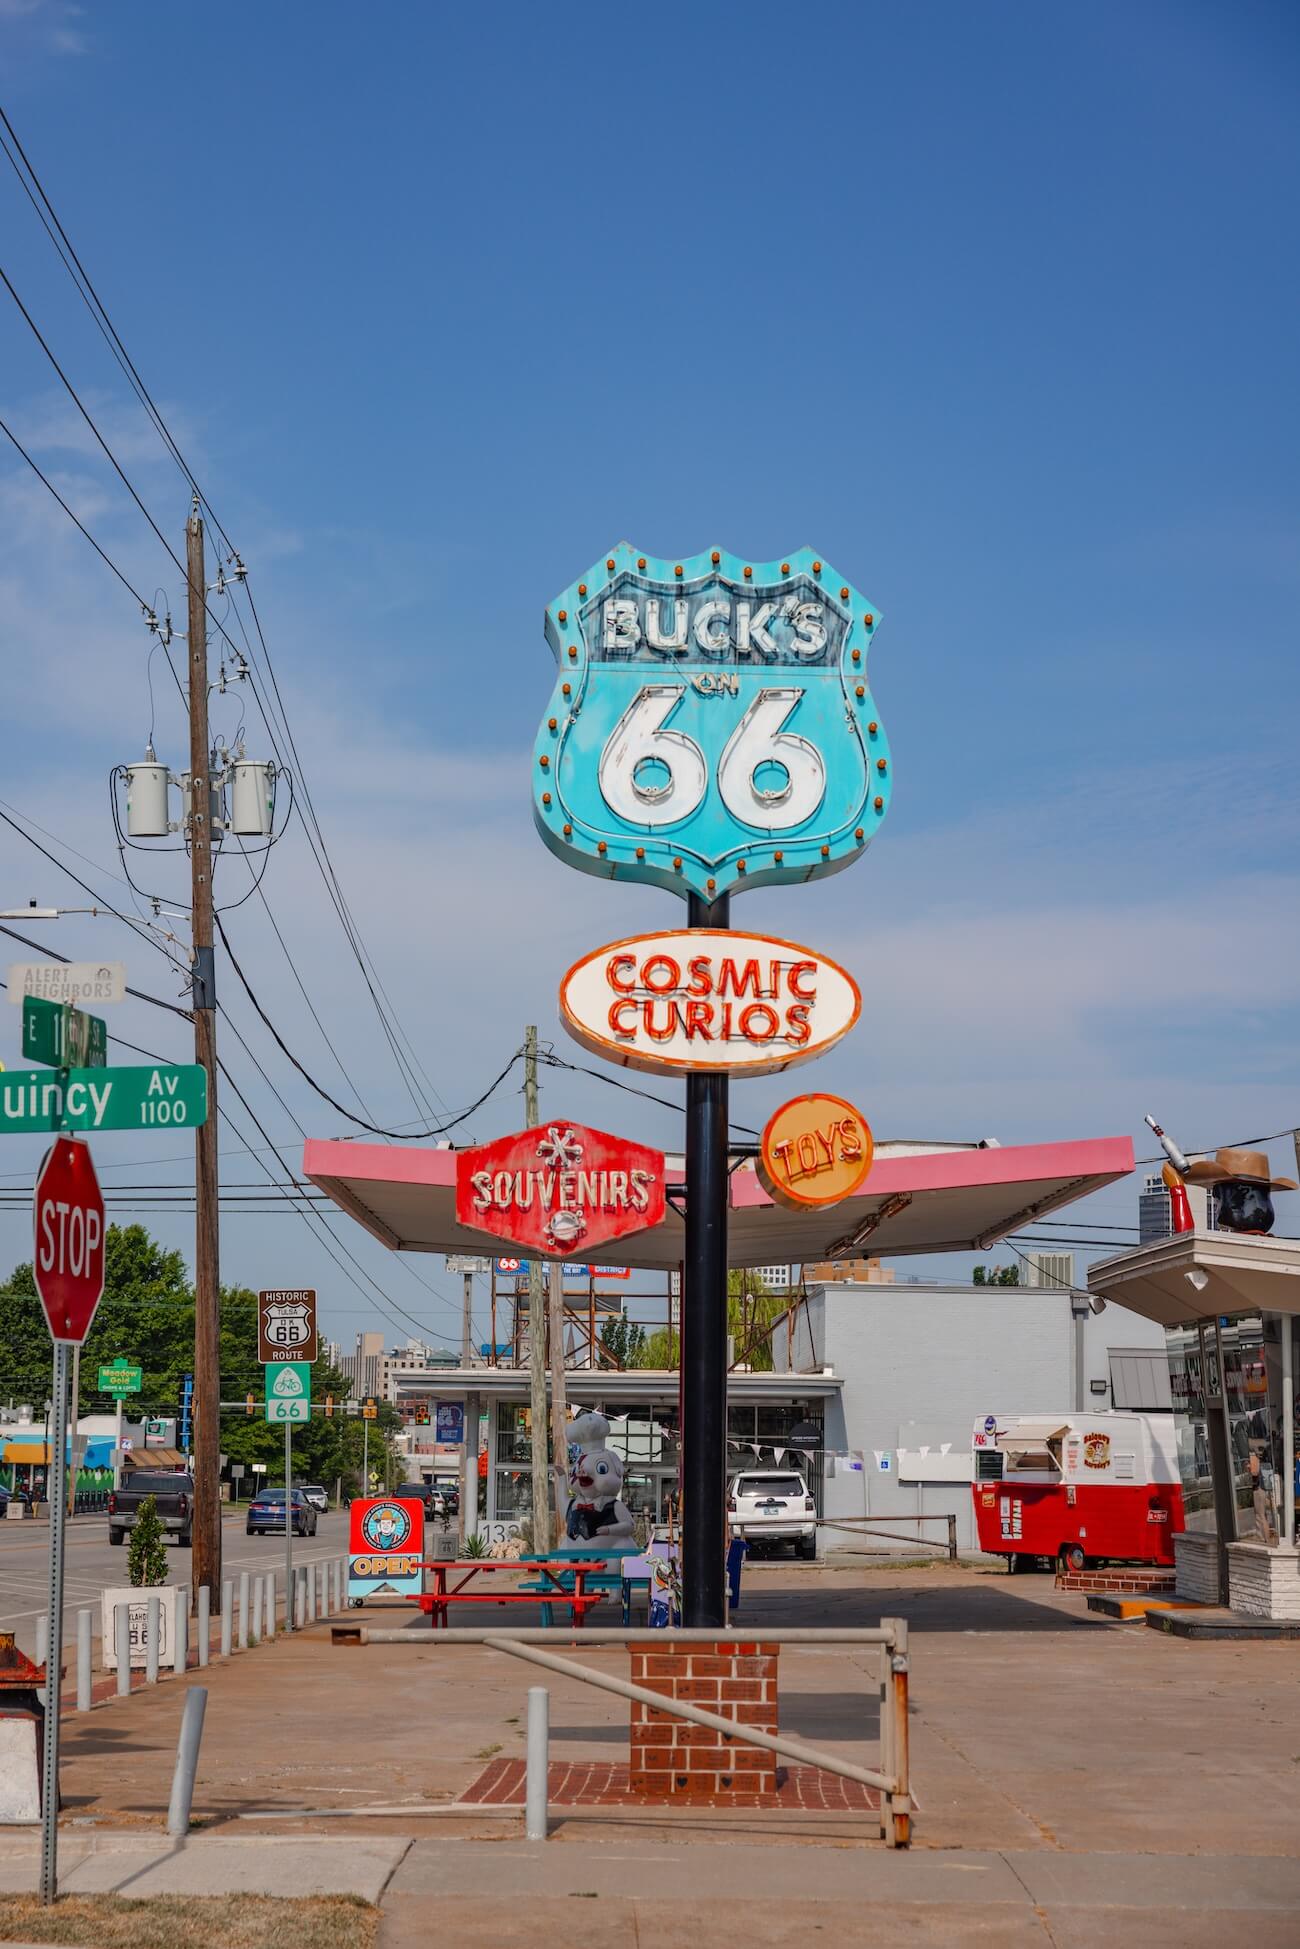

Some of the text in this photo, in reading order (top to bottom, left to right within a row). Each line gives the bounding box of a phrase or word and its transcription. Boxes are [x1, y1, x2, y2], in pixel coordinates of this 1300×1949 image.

[603, 597, 828, 654] BUCK'S
[692, 672, 740, 697] ON
[598, 685, 827, 830] 66
[24, 968, 70, 984] ALERT
[605, 954, 818, 999] COSMIC
[23, 982, 113, 998] NEIGHBORS
[29, 1015, 37, 1041] E
[607, 998, 816, 1044] CURIOS
[3, 1070, 179, 1126] uincy Av
[140, 1100, 187, 1124] 1100
[773, 1118, 862, 1184] TOYS
[470, 1170, 655, 1209] SOUVENIRS
[40, 1199, 101, 1279] STOP
[499, 1258, 519, 1269] 66
[594, 1265, 627, 1274] DISTRICT
[265, 1292, 309, 1301] HISTORIC
[278, 1308, 298, 1316] TULSA
[276, 1326, 300, 1341] 66
[272, 1350, 304, 1360] ROUTE
[102, 1368, 138, 1377] Meadow
[110, 1376, 130, 1385] Gold
[276, 1402, 301, 1418] 66
[353, 1557, 418, 1576] OPEN
